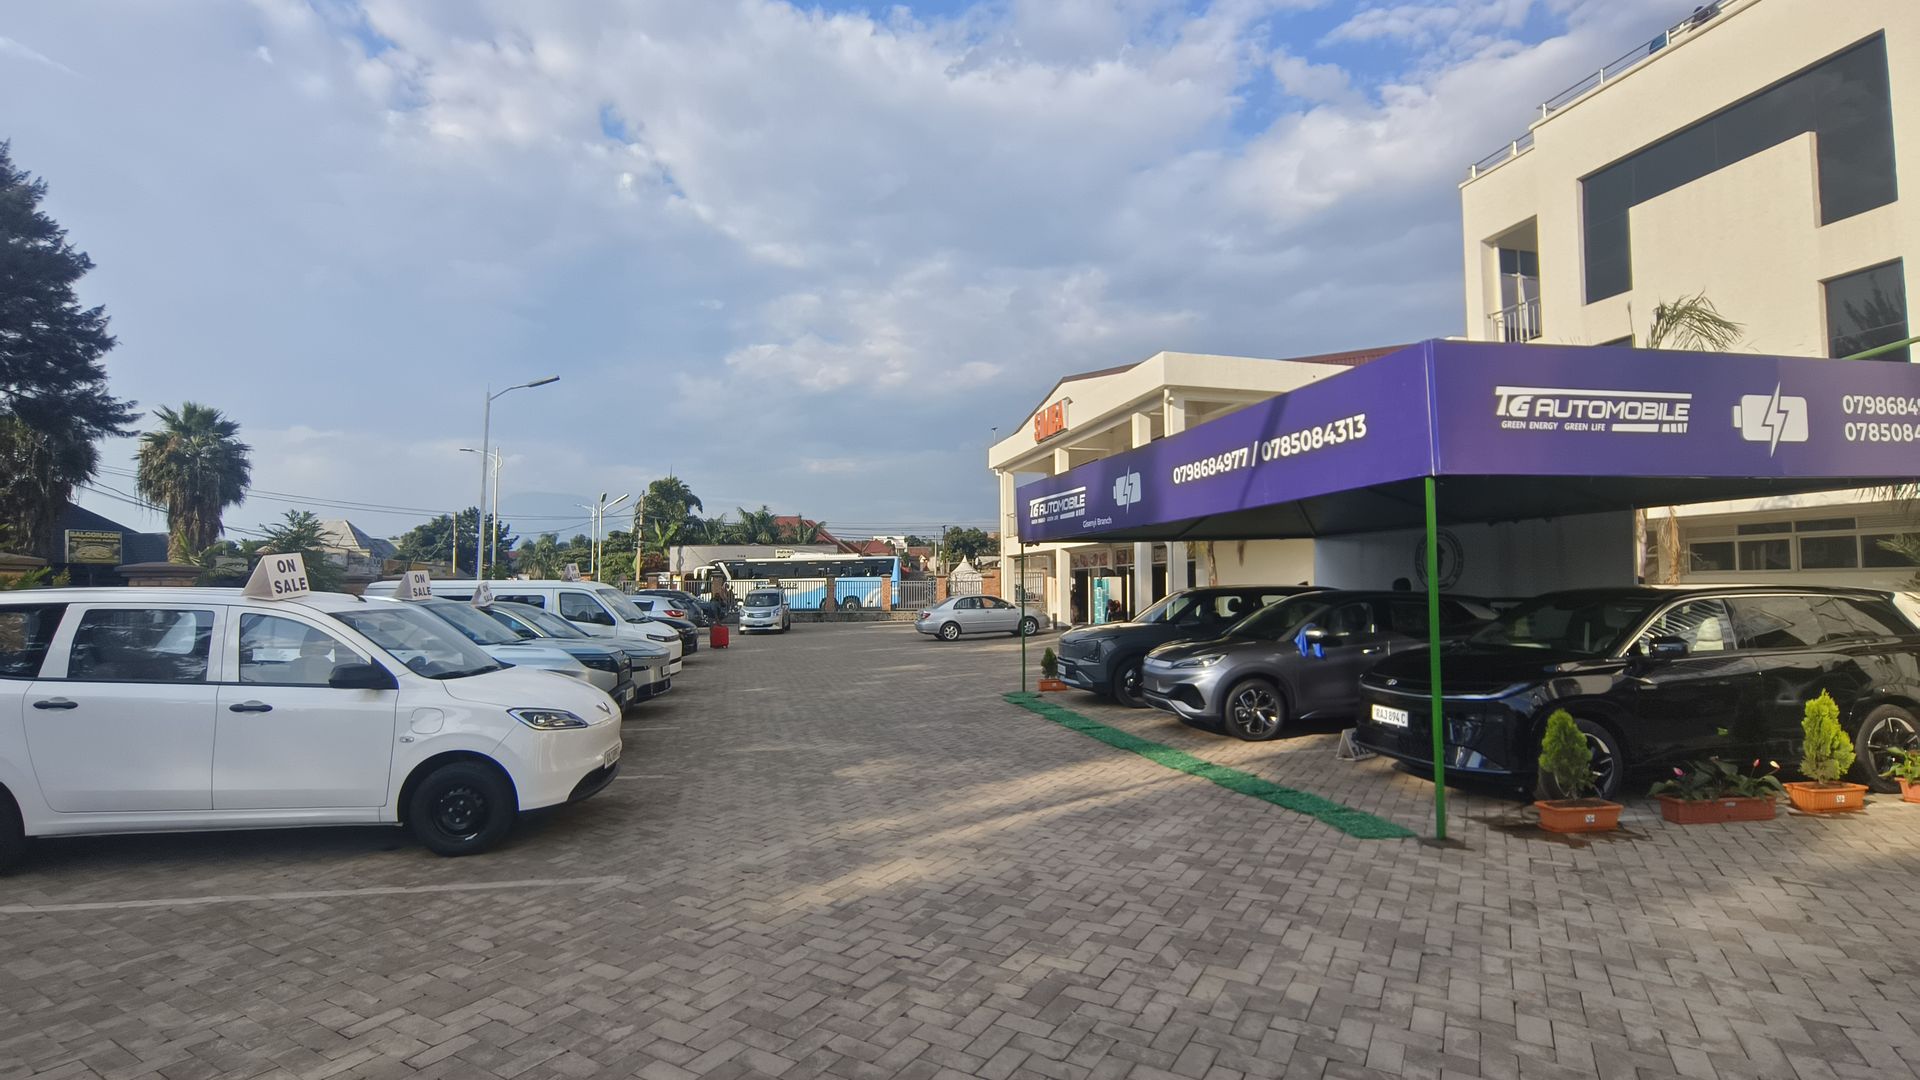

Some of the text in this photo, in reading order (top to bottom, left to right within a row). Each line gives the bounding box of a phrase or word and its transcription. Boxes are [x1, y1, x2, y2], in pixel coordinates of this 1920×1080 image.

[1535, 399, 1691, 421] AUTOMOBILE
[1842, 395, 1920, 415] 0798684
[1501, 420, 1606, 432] GREEN ENERGY GREEN LIFE
[1173, 414, 1367, 484] 0798684977 / 0785084313
[1039, 494, 1086, 516] AUTOMOBILE
[1097, 516, 1113, 526] Branch
[277, 559, 297, 573] ON
[274, 577, 308, 594] SALE
[414, 573, 426, 584] ON
[412, 586, 432, 597] SALE
[1388, 711, 1400, 722] 894
[1401, 713, 1406, 724] C
